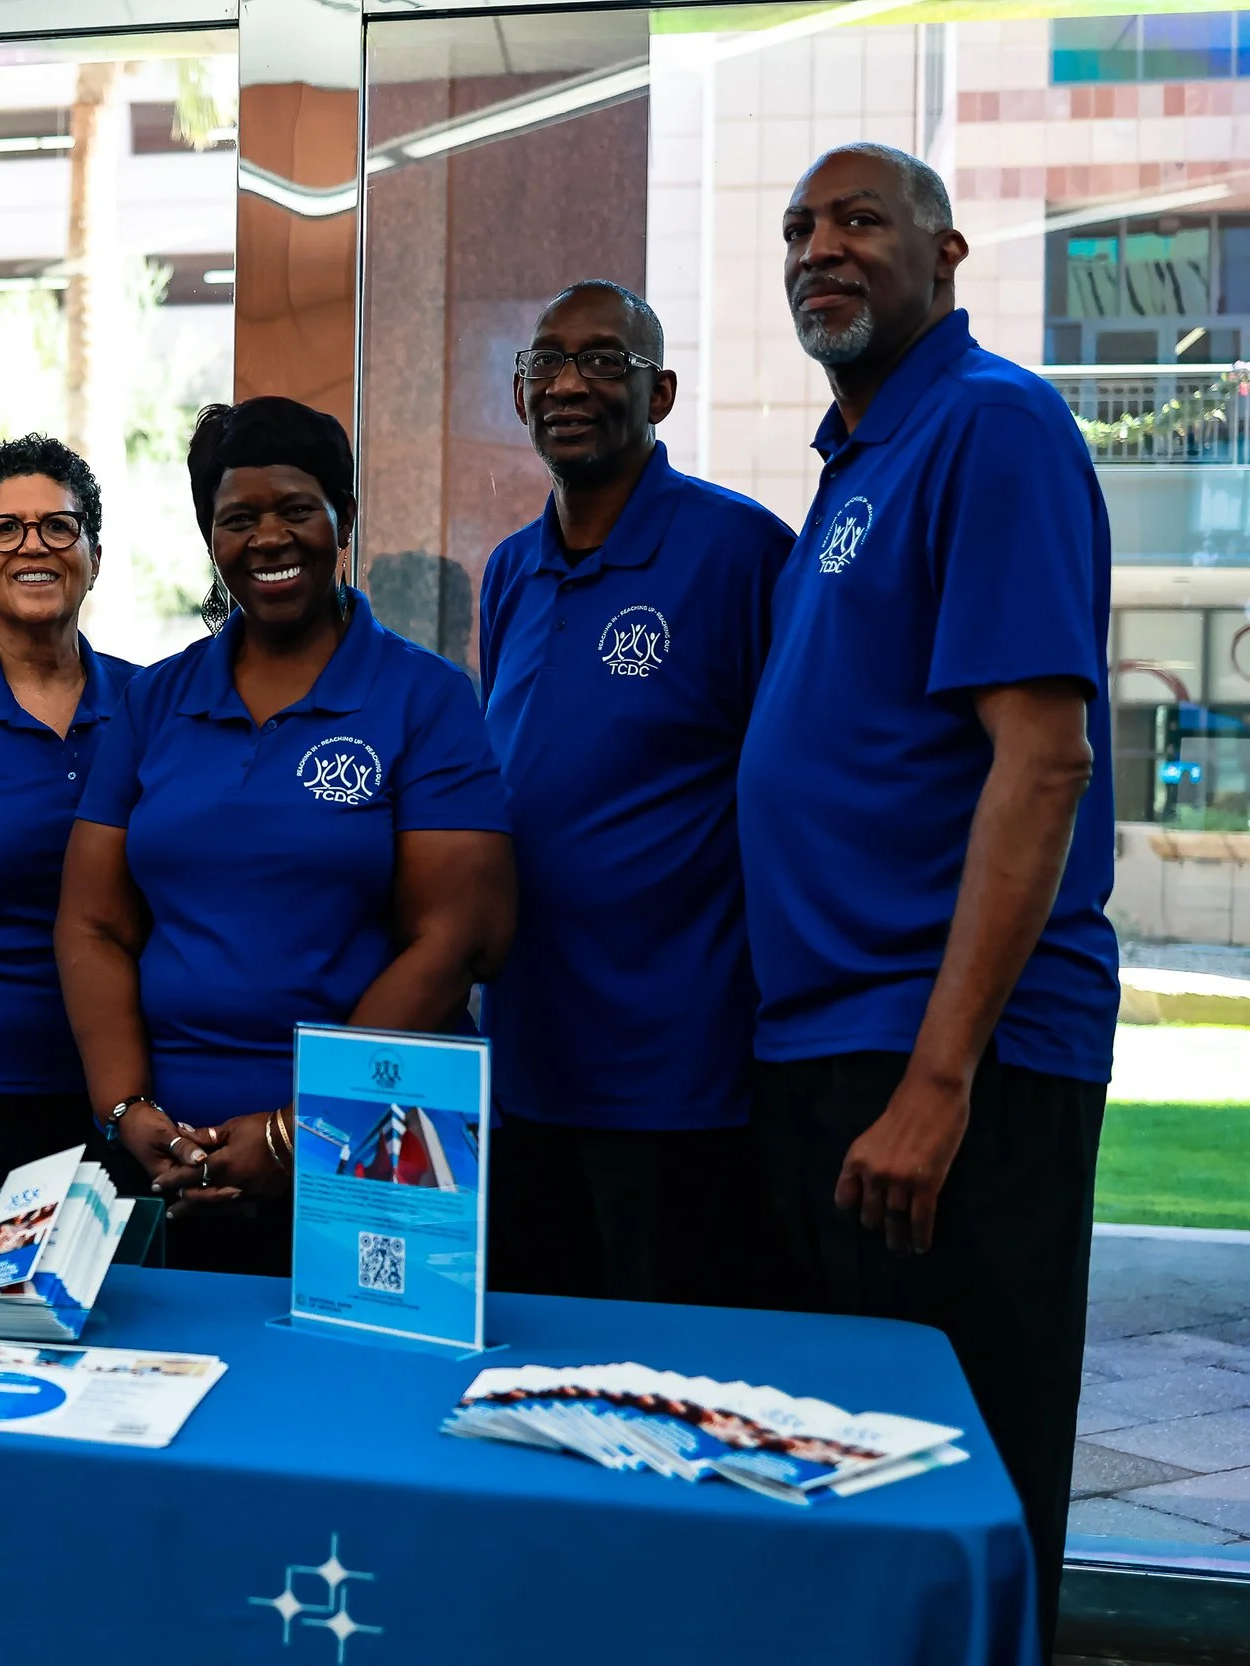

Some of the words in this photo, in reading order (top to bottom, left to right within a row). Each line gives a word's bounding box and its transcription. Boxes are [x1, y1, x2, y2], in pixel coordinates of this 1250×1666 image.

[819, 561, 844, 573] TCDC
[620, 605, 647, 616] REACHING
[609, 663, 649, 677] TCDC
[321, 736, 353, 746] REACHING
[365, 745, 381, 772] REACHING
[313, 789, 359, 805] TCDC
